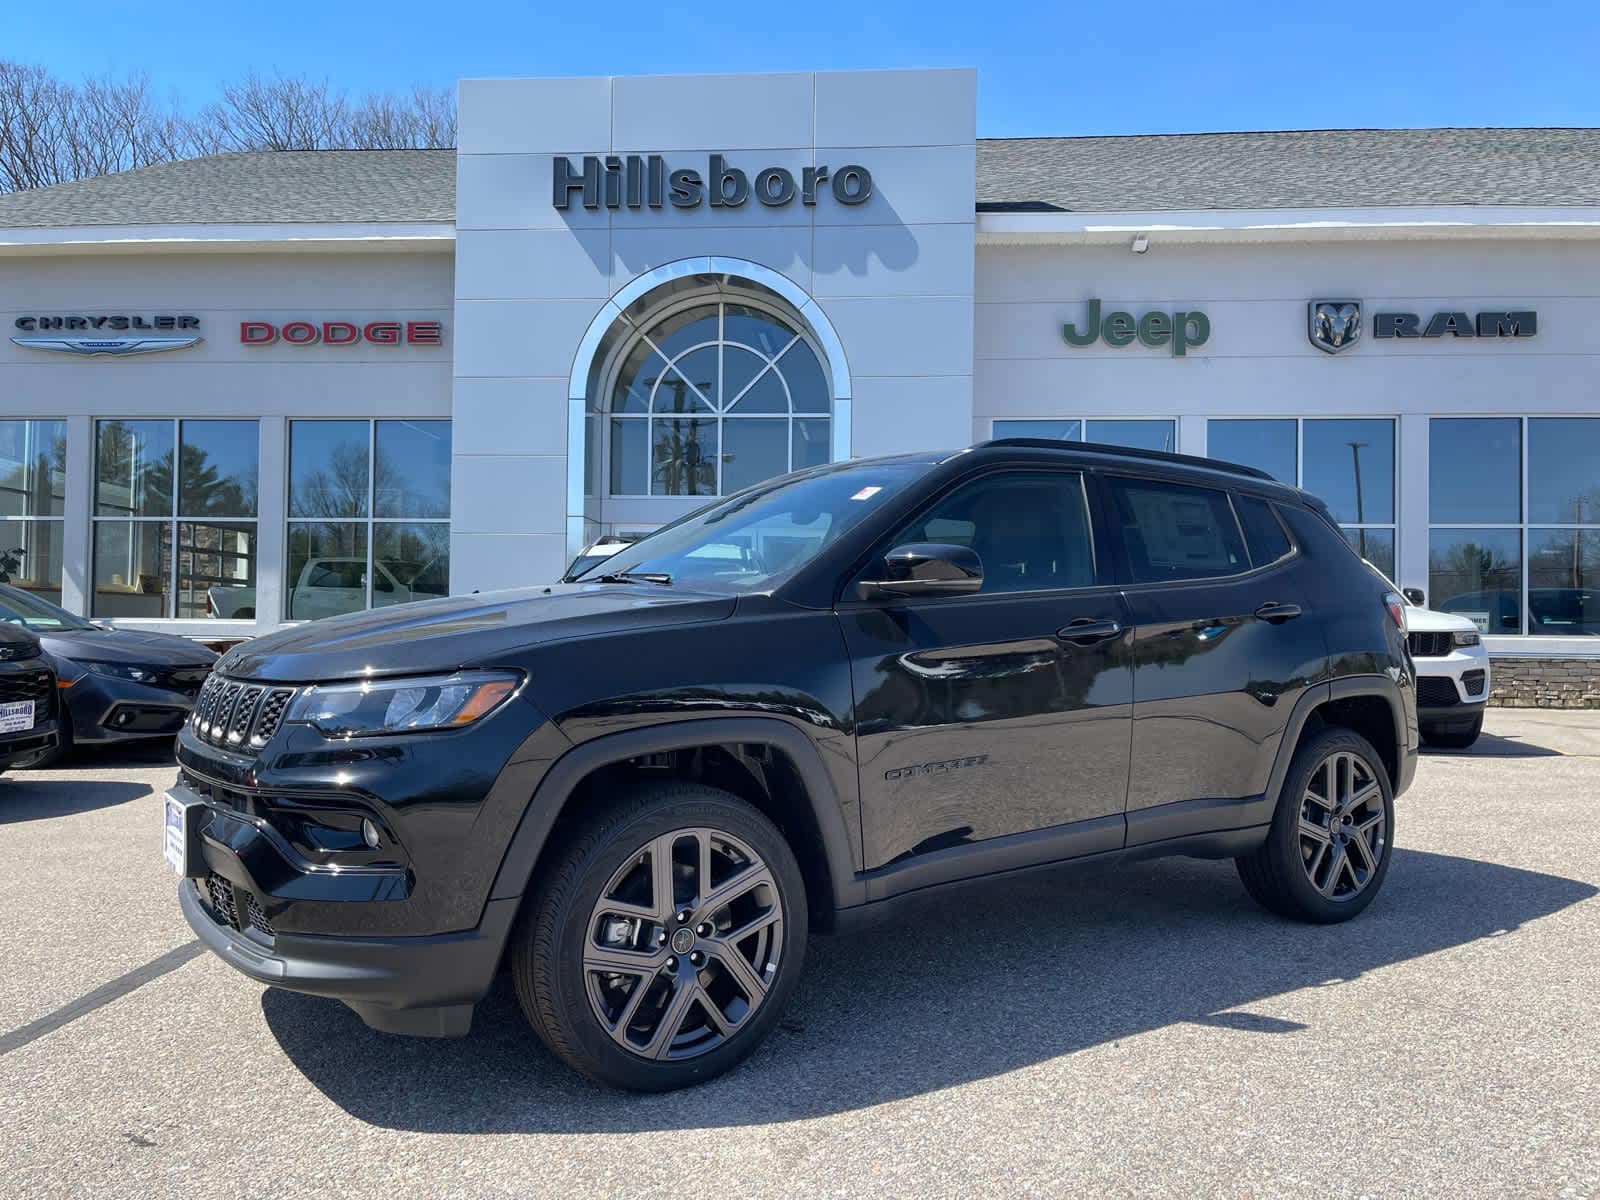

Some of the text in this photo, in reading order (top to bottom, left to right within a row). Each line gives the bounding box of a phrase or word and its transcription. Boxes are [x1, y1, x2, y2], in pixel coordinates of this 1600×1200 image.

[552, 153, 873, 209] Hillsboro
[14, 315, 200, 330] CHRYSLER
[240, 321, 442, 345] DODGE
[1062, 298, 1210, 358] Jeep
[1374, 311, 1537, 338] RAM
